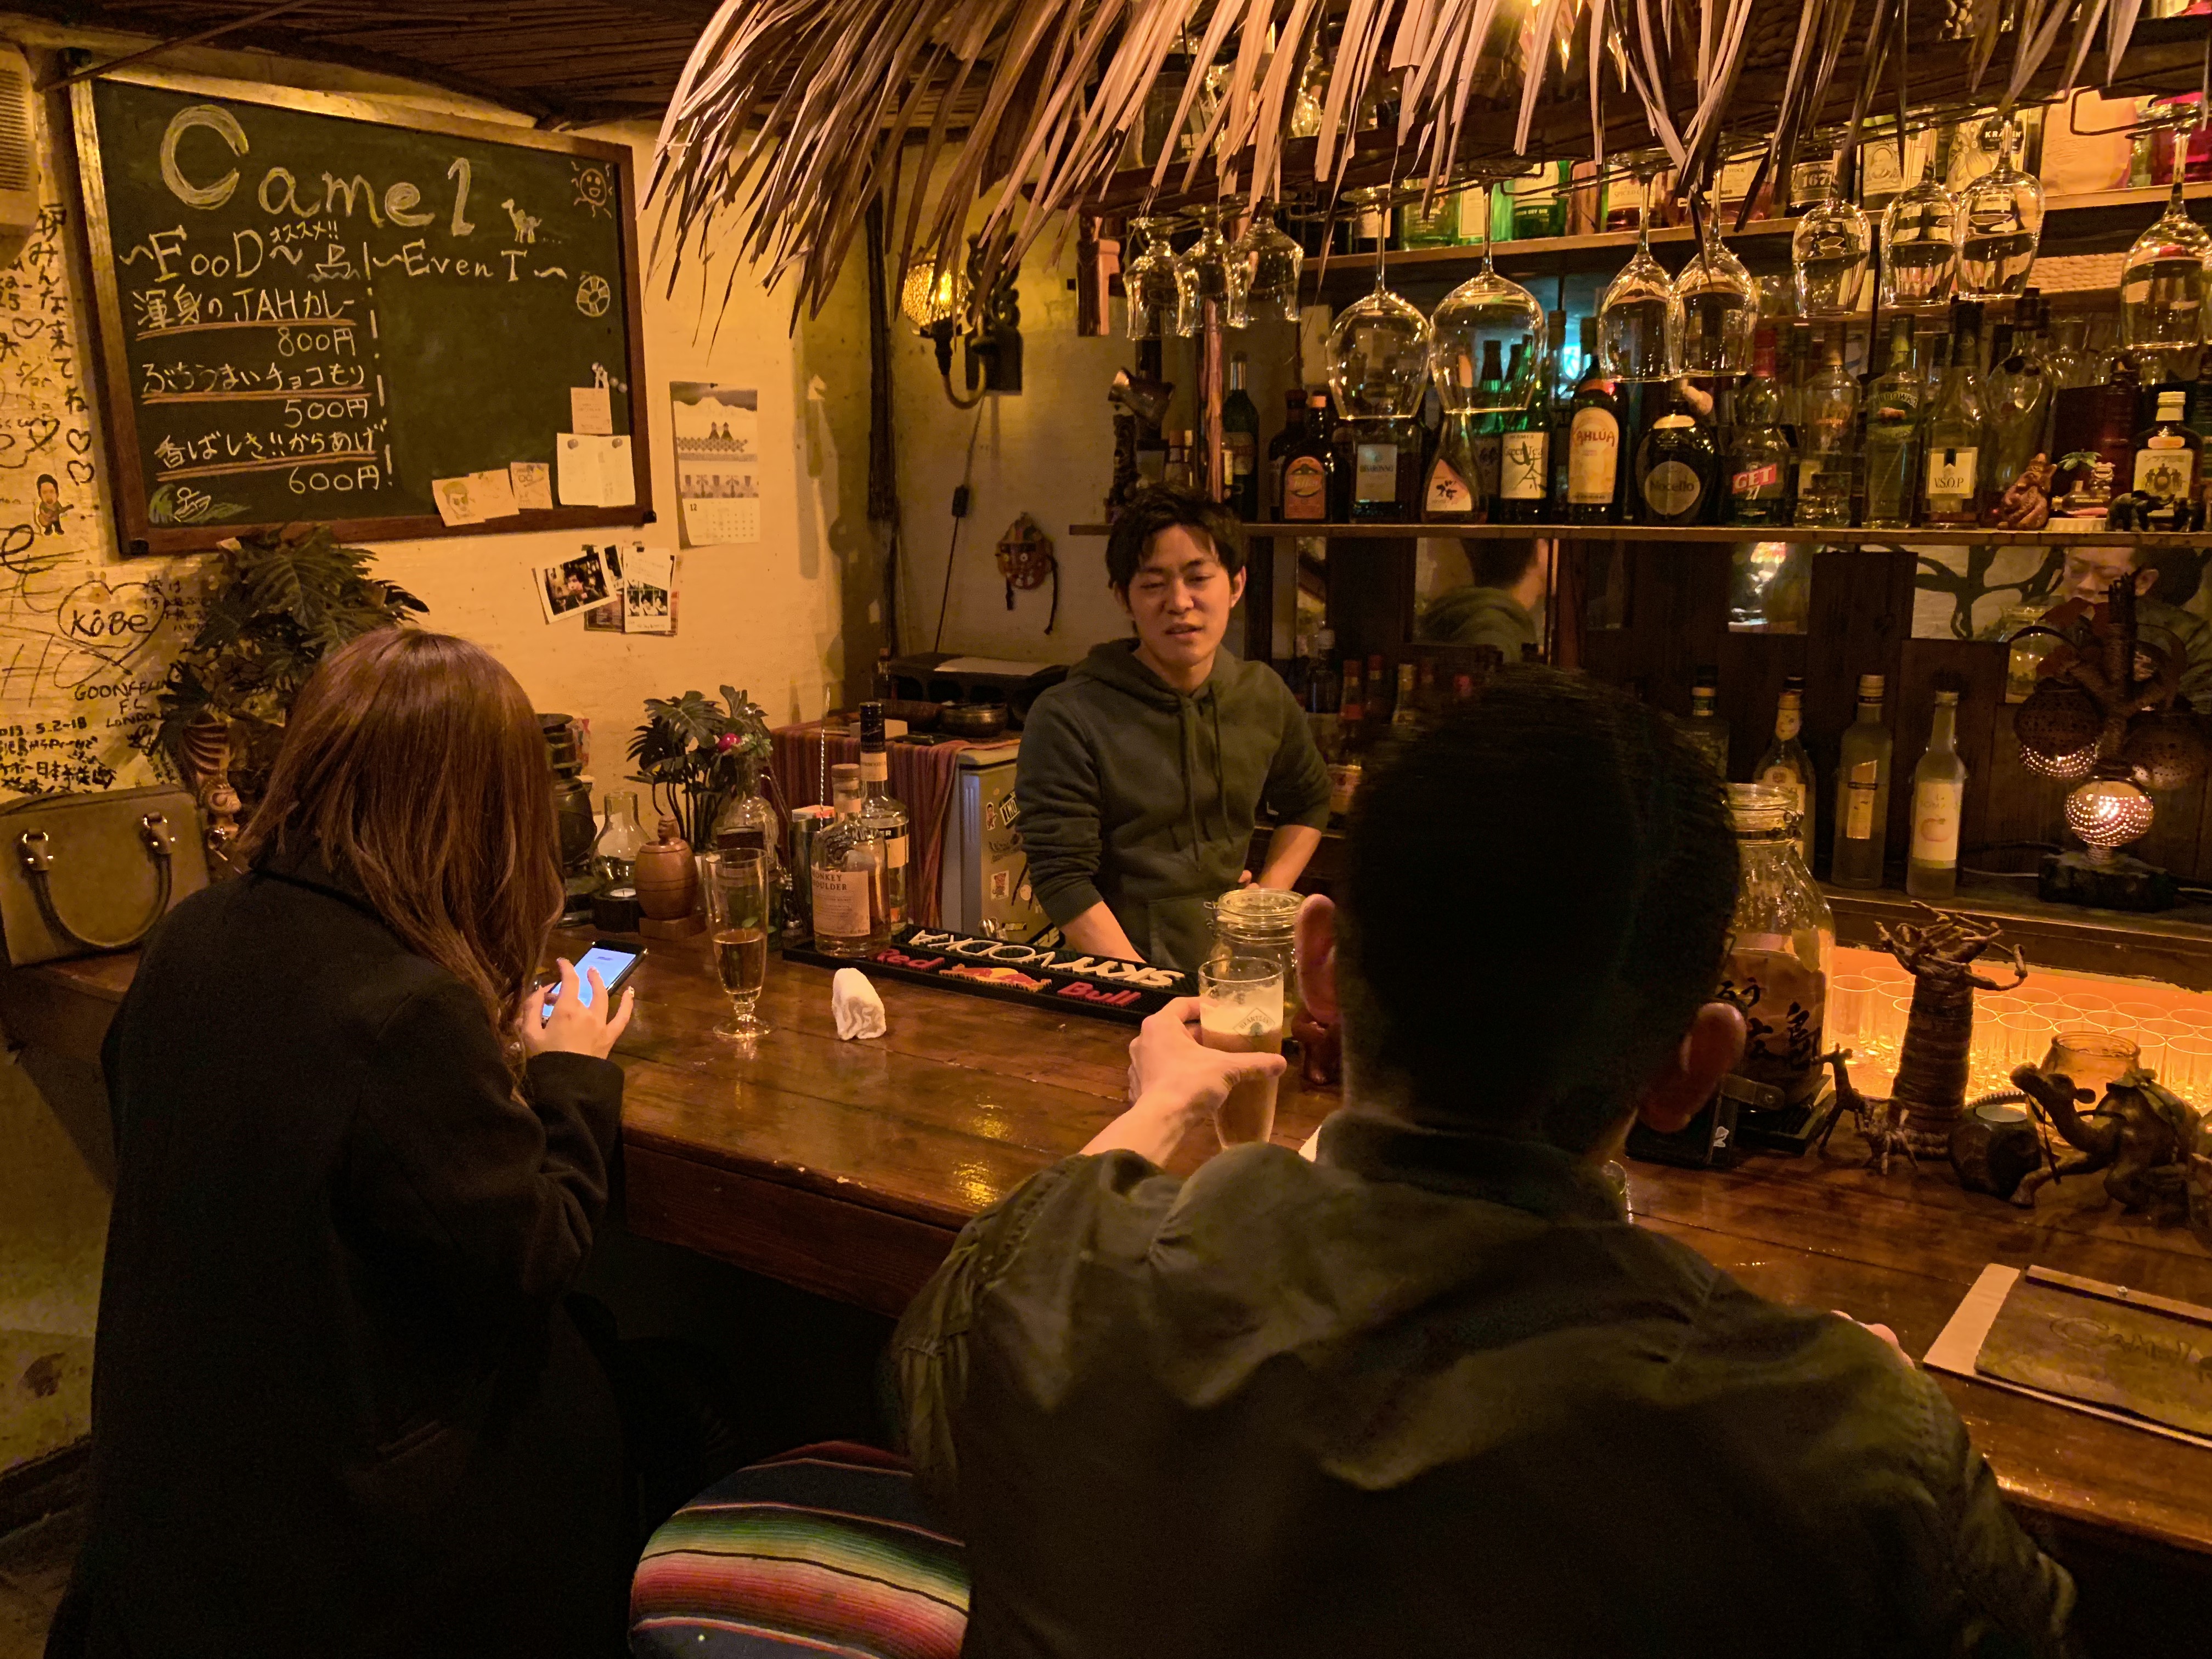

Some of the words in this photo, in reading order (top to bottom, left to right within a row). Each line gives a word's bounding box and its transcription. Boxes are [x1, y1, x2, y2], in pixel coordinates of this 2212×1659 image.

[1734, 467, 1773, 489] GET
[876, 948, 945, 971] Red
[1057, 981, 1142, 1007] Bull
